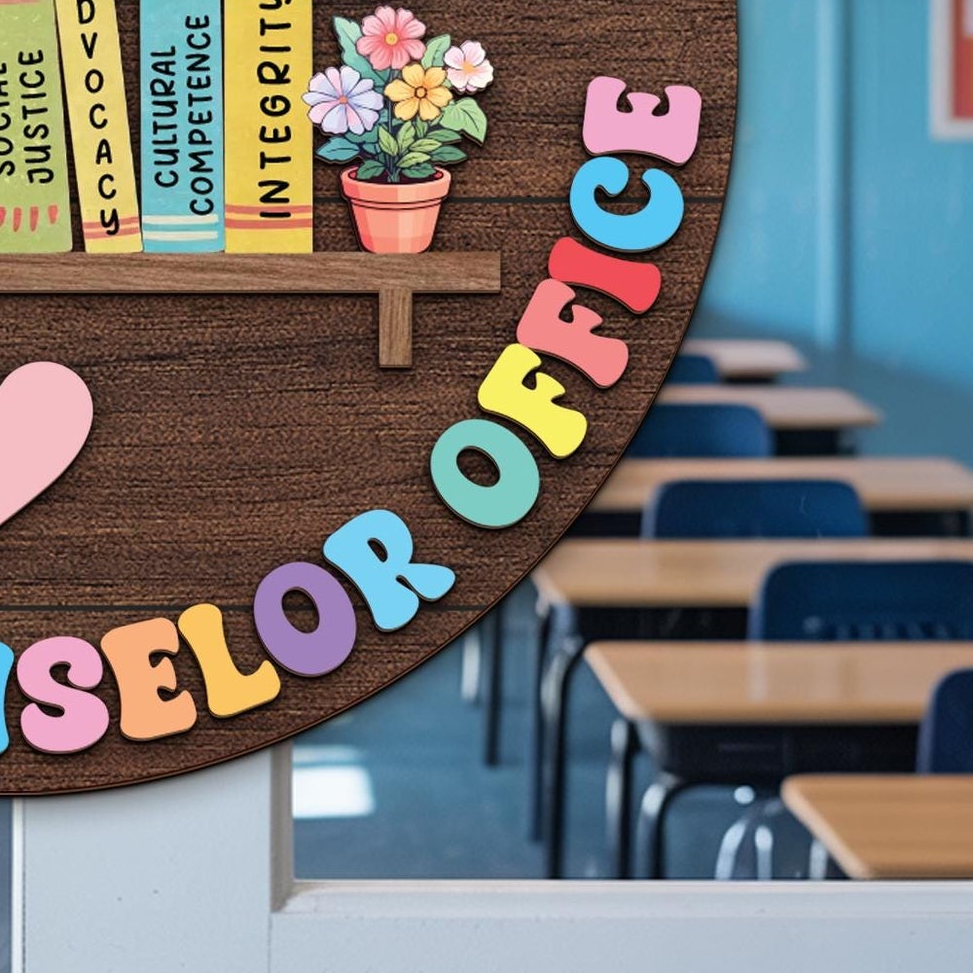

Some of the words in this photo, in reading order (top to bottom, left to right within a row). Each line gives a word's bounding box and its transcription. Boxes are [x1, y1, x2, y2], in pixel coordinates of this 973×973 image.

[18, 49, 55, 185] JUSTICE
[150, 45, 179, 189] CULTURAL
[185, 14, 215, 217] COMPETENCE
[430, 75, 703, 528] OFFICE
